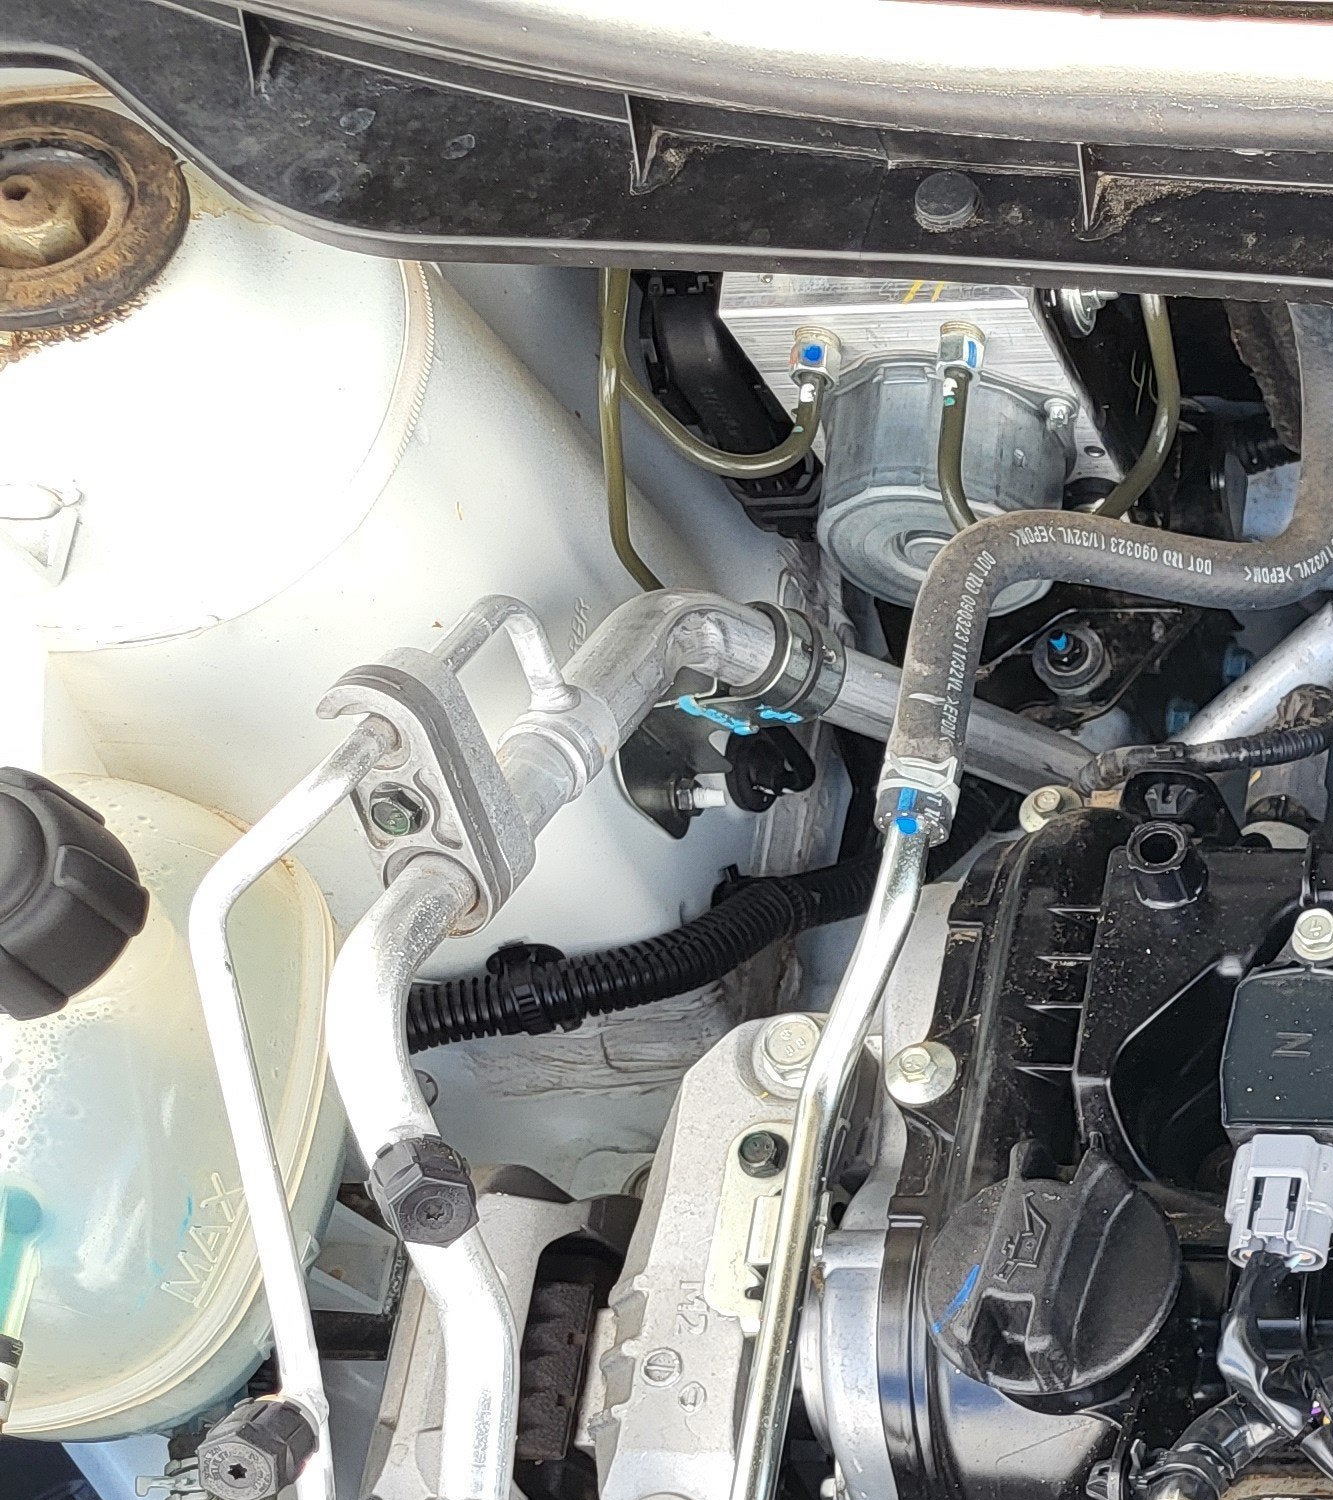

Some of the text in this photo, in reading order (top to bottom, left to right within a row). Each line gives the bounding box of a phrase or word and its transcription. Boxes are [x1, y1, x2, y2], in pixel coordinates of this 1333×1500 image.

[1110, 537, 1159, 561] 090323
[1187, 557, 1212, 575] DOT
[161, 1172, 245, 1309] MAX
